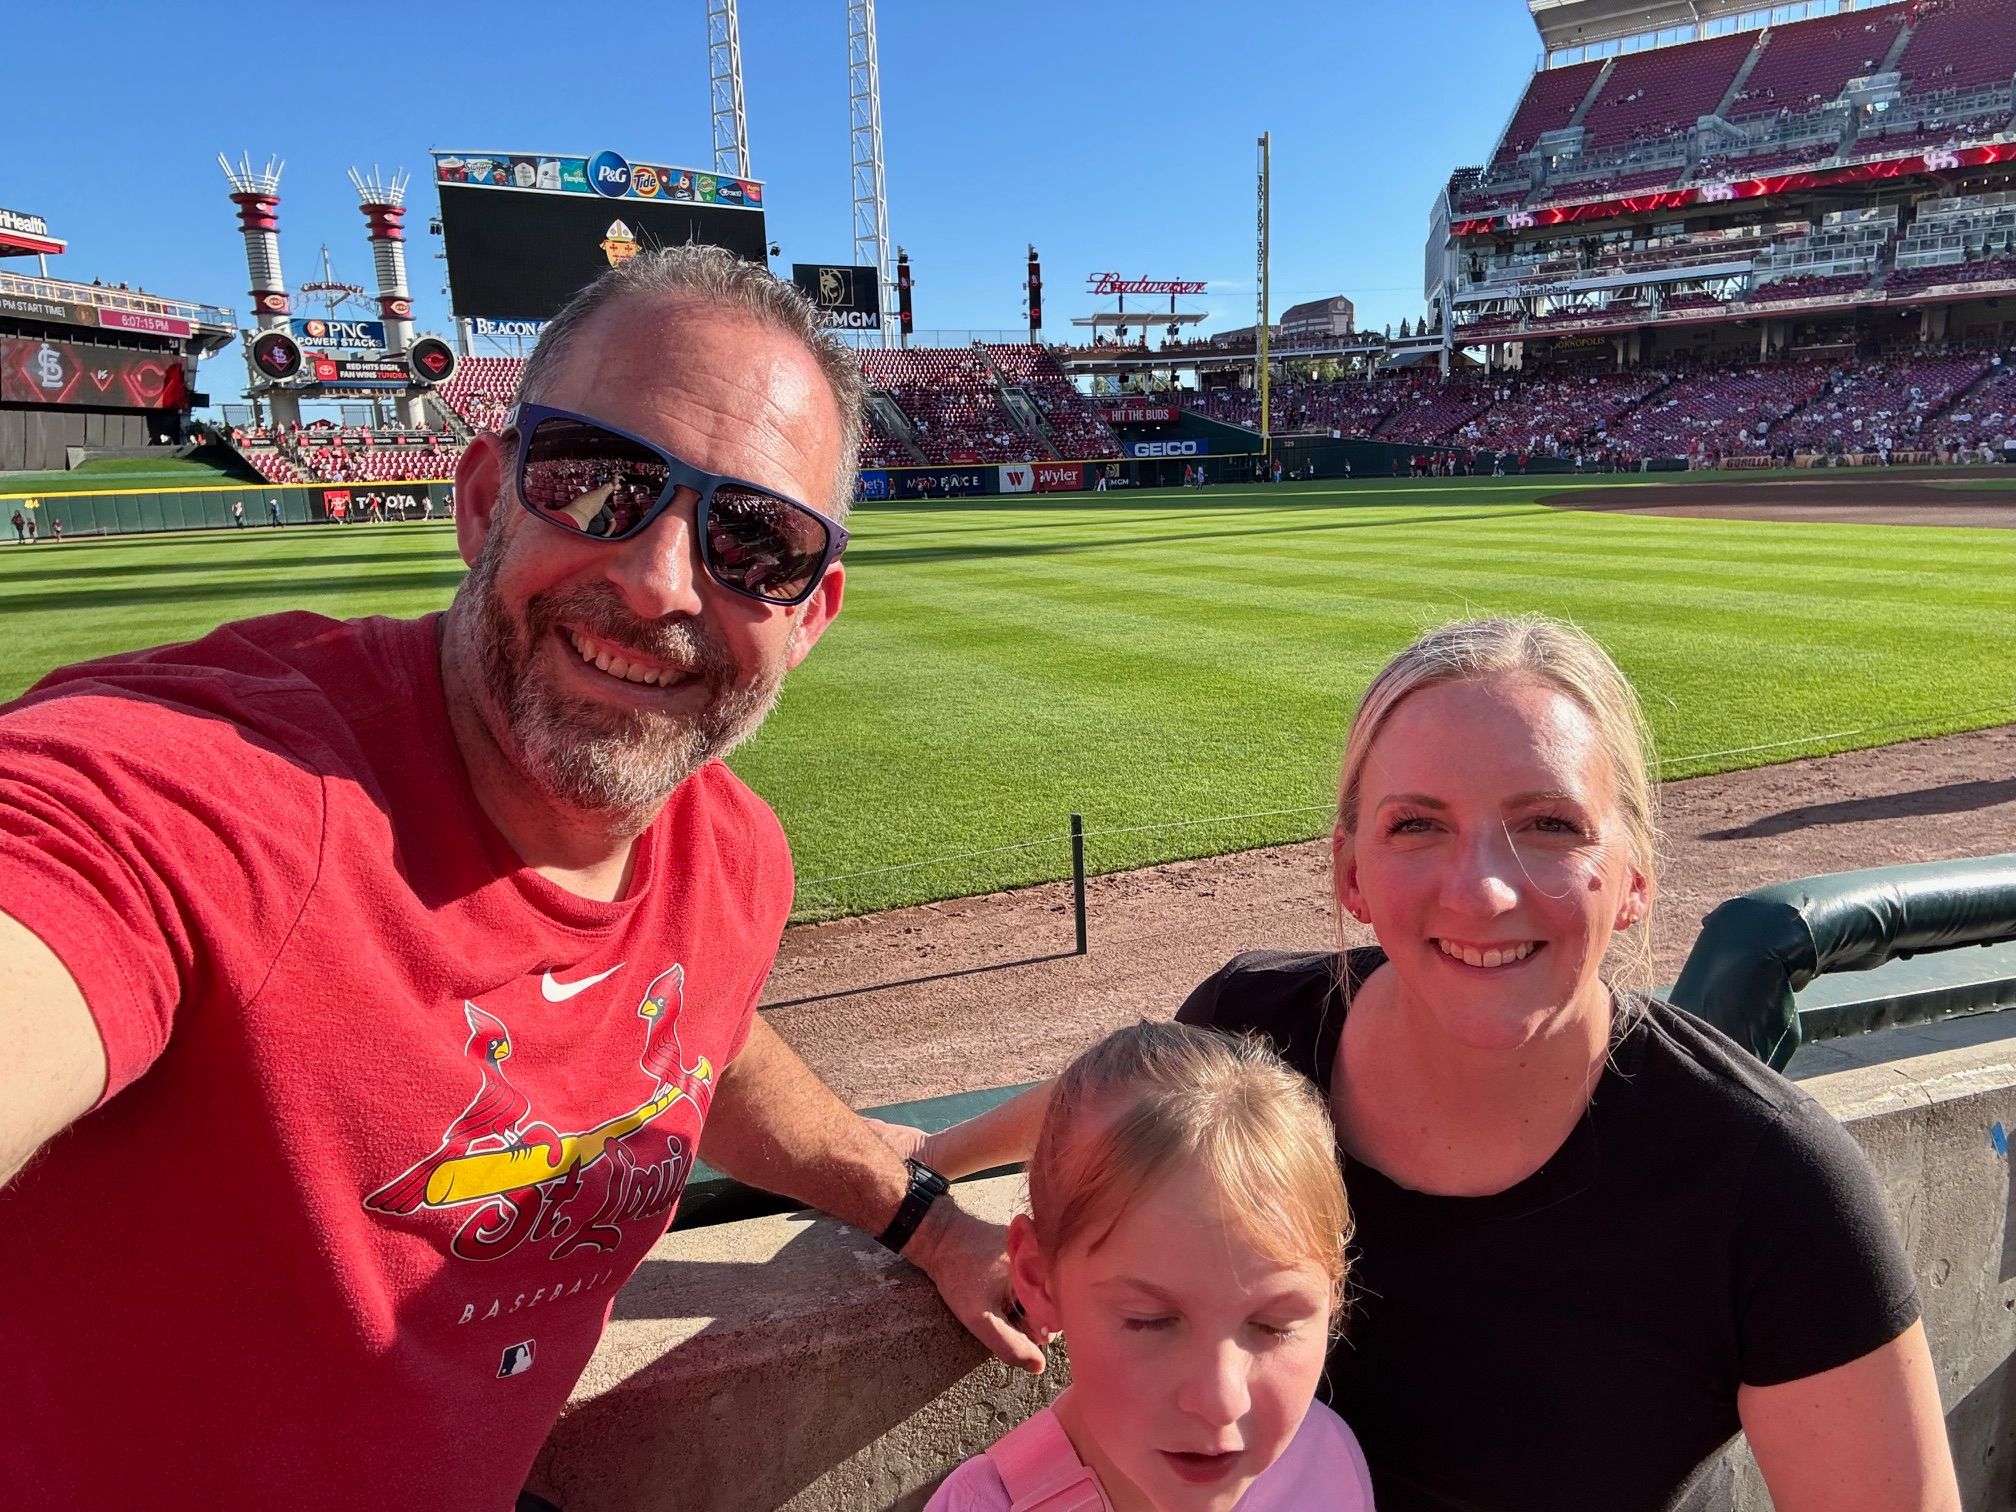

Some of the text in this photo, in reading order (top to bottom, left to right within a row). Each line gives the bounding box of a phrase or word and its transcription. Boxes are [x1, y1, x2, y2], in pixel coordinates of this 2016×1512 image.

[598, 165, 627, 183] P&G
[633, 174, 656, 190] Tide
[0, 210, 47, 235] riHealth
[1090, 272, 1206, 295] Budweiser
[1519, 285, 1570, 296] handlebar
[3, 299, 16, 309] PM
[17, 301, 43, 312] START
[121, 314, 169, 331] 6:07:15 PM
[327, 322, 371, 339] PNC
[476, 317, 536, 335] BEACON
[297, 336, 383, 347] POWER STACKS
[356, 371, 377, 379] WINS
[377, 371, 408, 379] TUNDRA
[362, 363, 379, 371] HITS
[1112, 408, 1169, 421] HIT THE BUDS
[1134, 441, 1197, 457] GEICO
[1726, 457, 1769, 468] GORILLA
[1040, 468, 1079, 486] Wyler
[450, 1157, 583, 1262] St.
